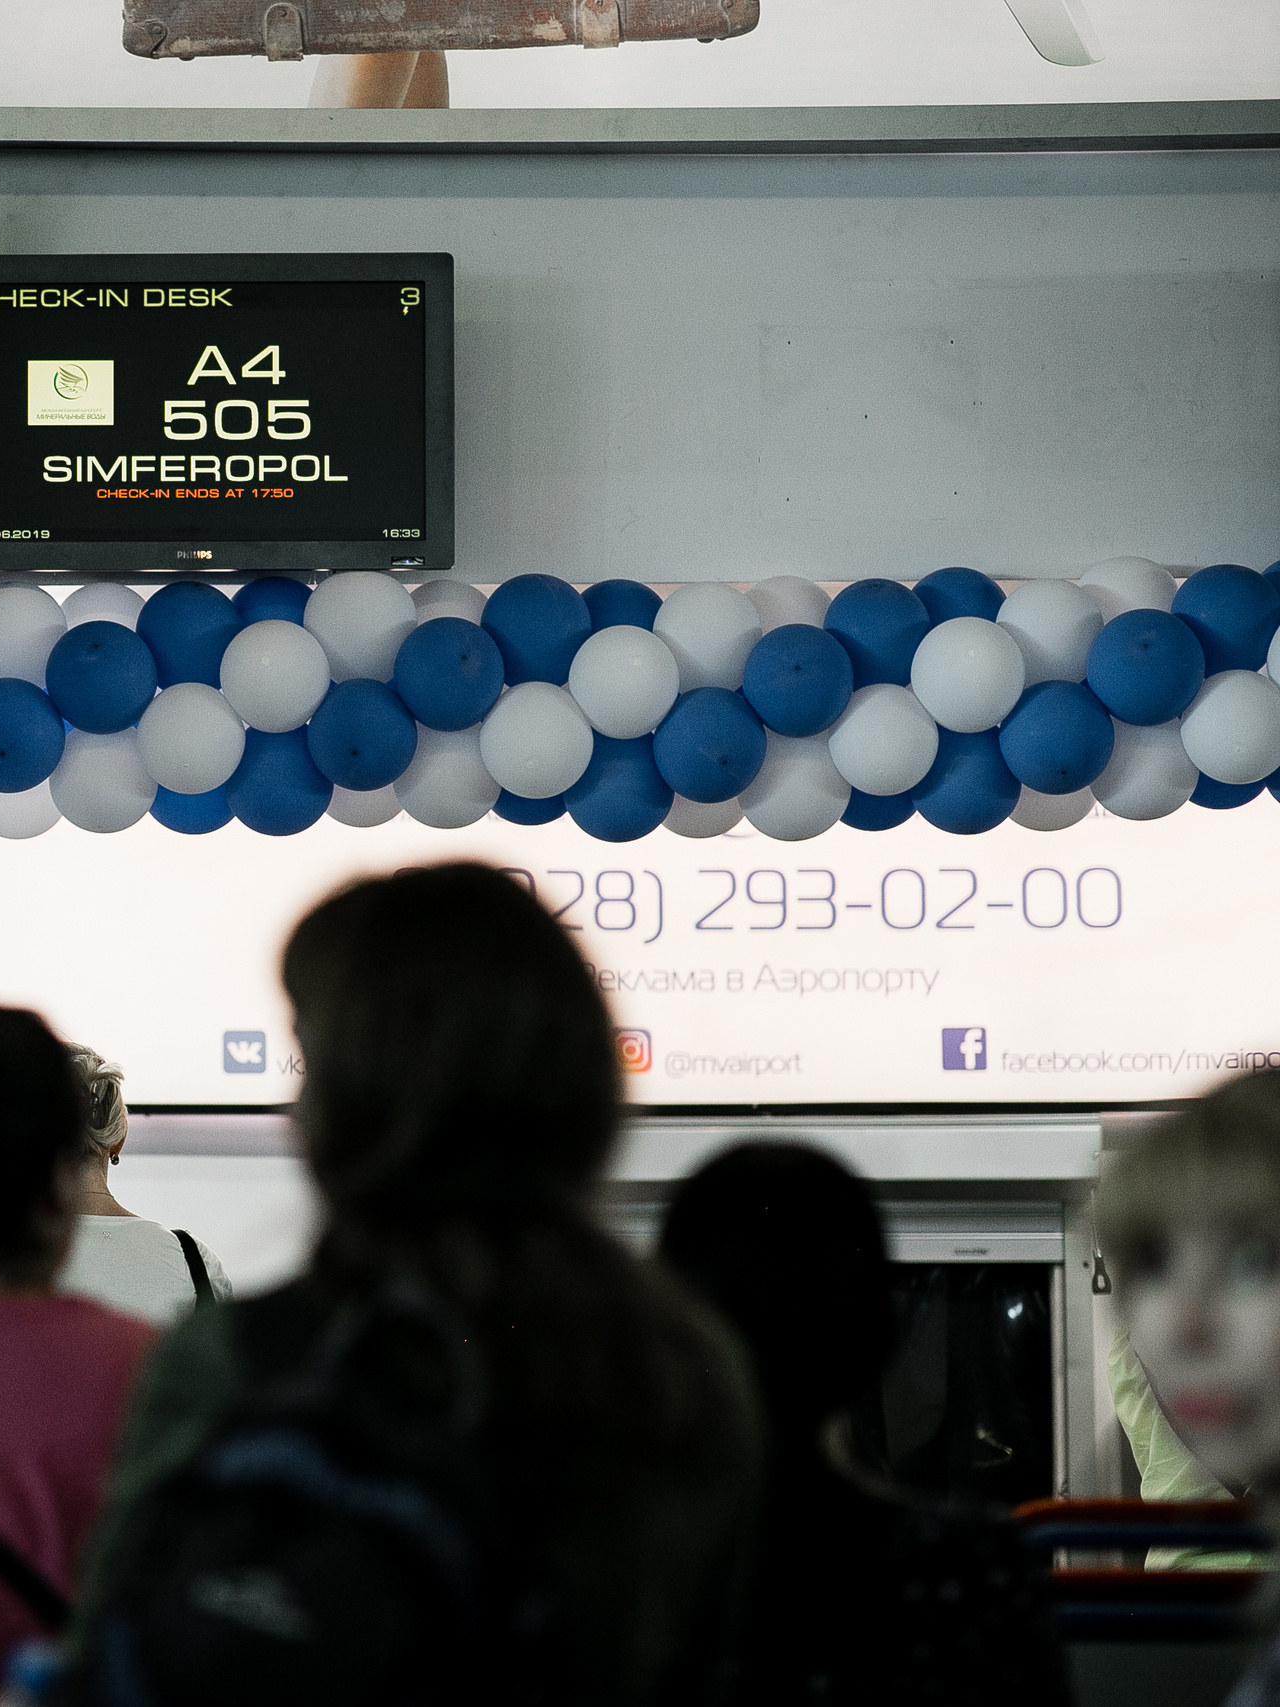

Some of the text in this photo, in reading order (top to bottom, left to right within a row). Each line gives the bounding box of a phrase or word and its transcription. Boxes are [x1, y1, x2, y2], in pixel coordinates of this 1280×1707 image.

[144, 288, 233, 308] DESK
[401, 288, 420, 306] 3
[187, 345, 287, 386] A4
[163, 400, 312, 441] 505
[43, 455, 349, 483] SIMFEROPOL
[96, 488, 294, 499] CHECK-IN ENDS AT 17:50
[382, 529, 421, 538] 16:33
[177, 550, 213, 560] PHILIPS
[496, 867, 1124, 944] 28) 293-02-00
[726, 969, 745, 992] в
[753, 963, 940, 997] Аэропорту
[664, 1051, 803, 1078] @mvairport
